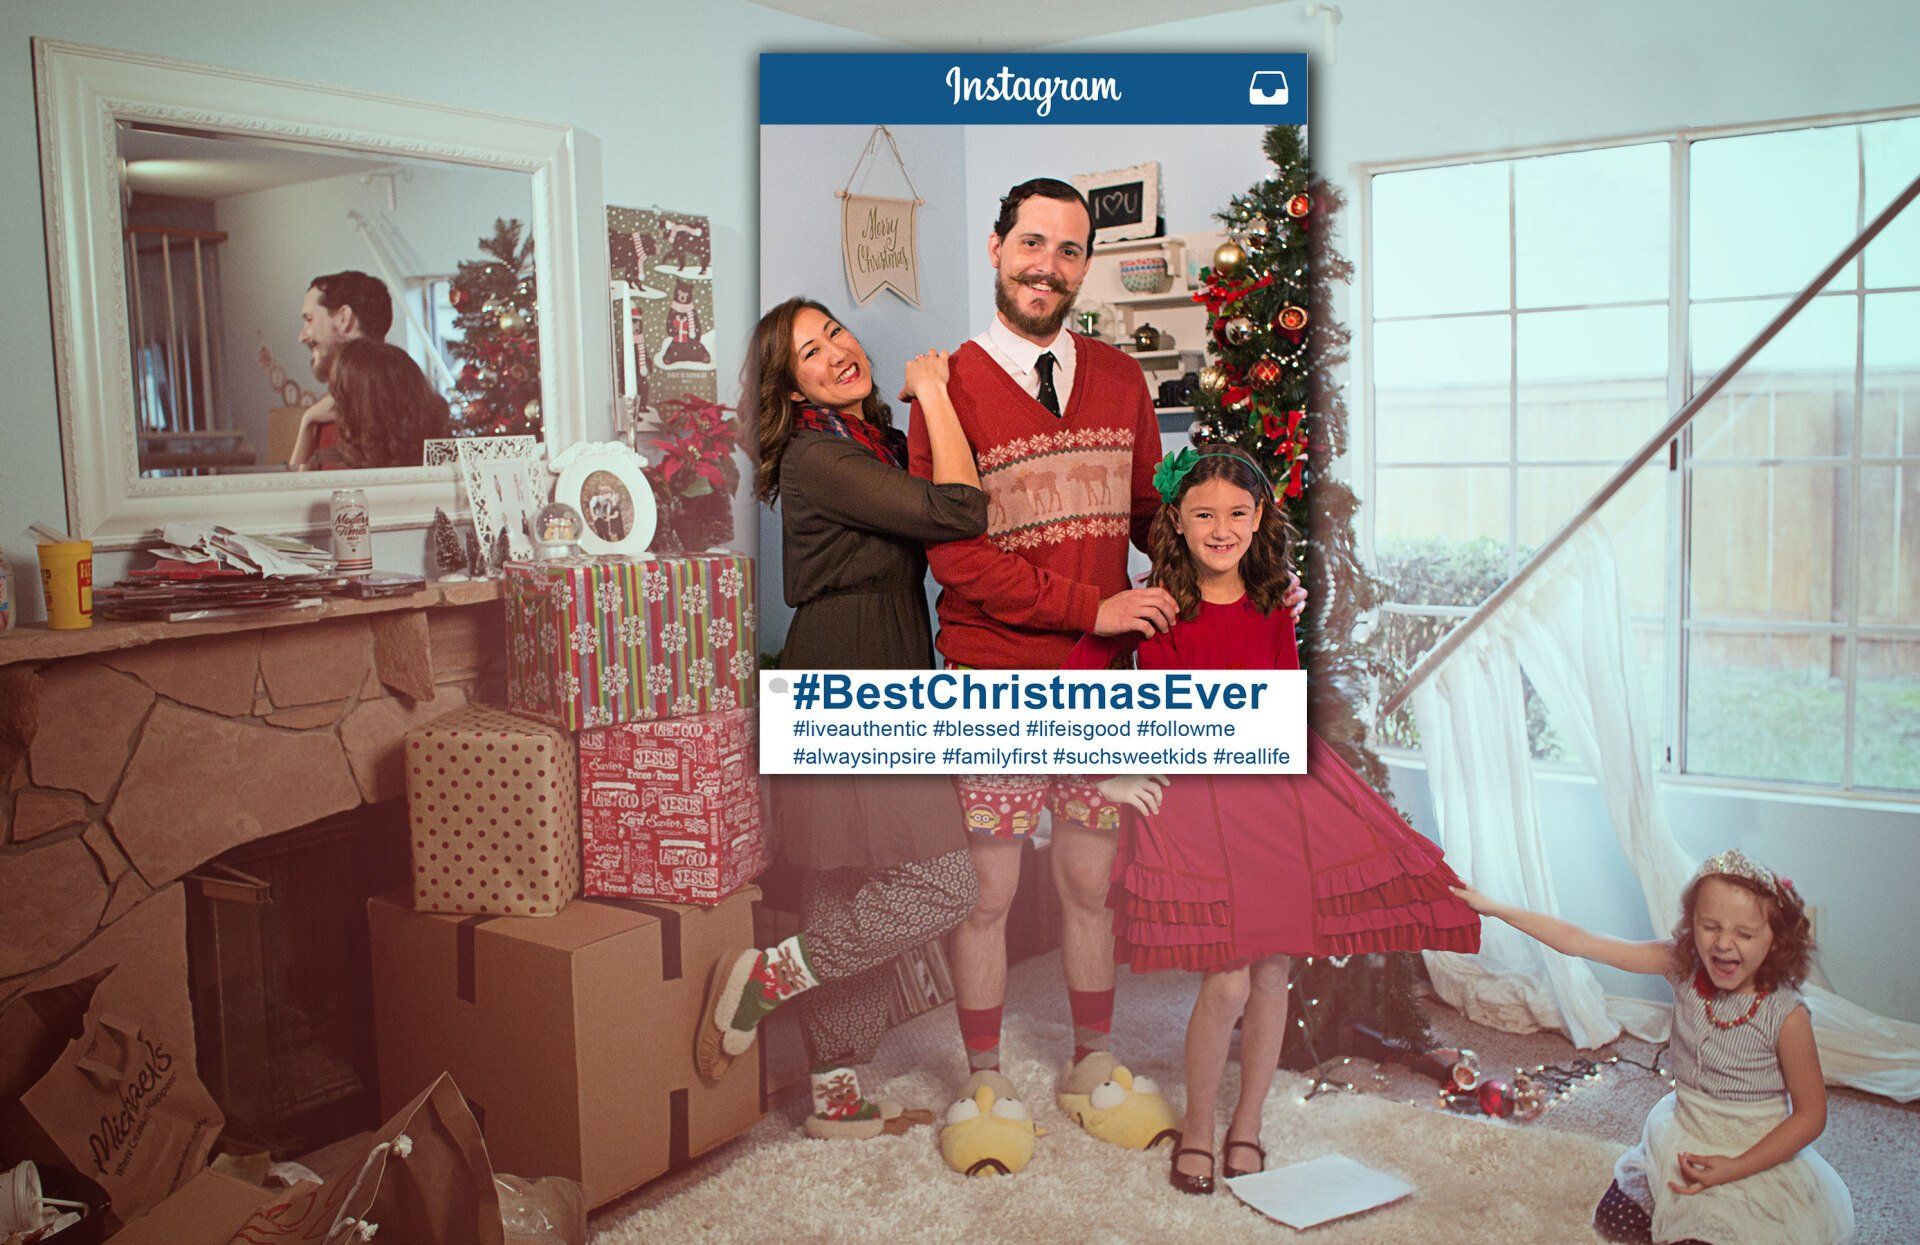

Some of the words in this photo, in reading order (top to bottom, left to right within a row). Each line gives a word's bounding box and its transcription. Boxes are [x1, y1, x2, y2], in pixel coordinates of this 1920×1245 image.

[1094, 195, 1101, 219] I
[1123, 190, 1138, 214] U
[861, 206, 899, 252] Merry
[857, 243, 909, 274] Christmas
[335, 525, 367, 536] Times
[681, 723, 703, 738] GOD
[635, 748, 677, 768] JESUS
[626, 768, 652, 780] Prince
[656, 769, 680, 781] Peace
[618, 792, 639, 809] GOD
[660, 796, 702, 813] JESUS
[617, 810, 646, 828] Lord
[592, 853, 622, 870] Lord
[686, 851, 708, 868] GOD
[674, 868, 716, 887] JESUS
[603, 881, 628, 894] Prince
[631, 883, 655, 895] Peace
[691, 887, 718, 899] Prince
